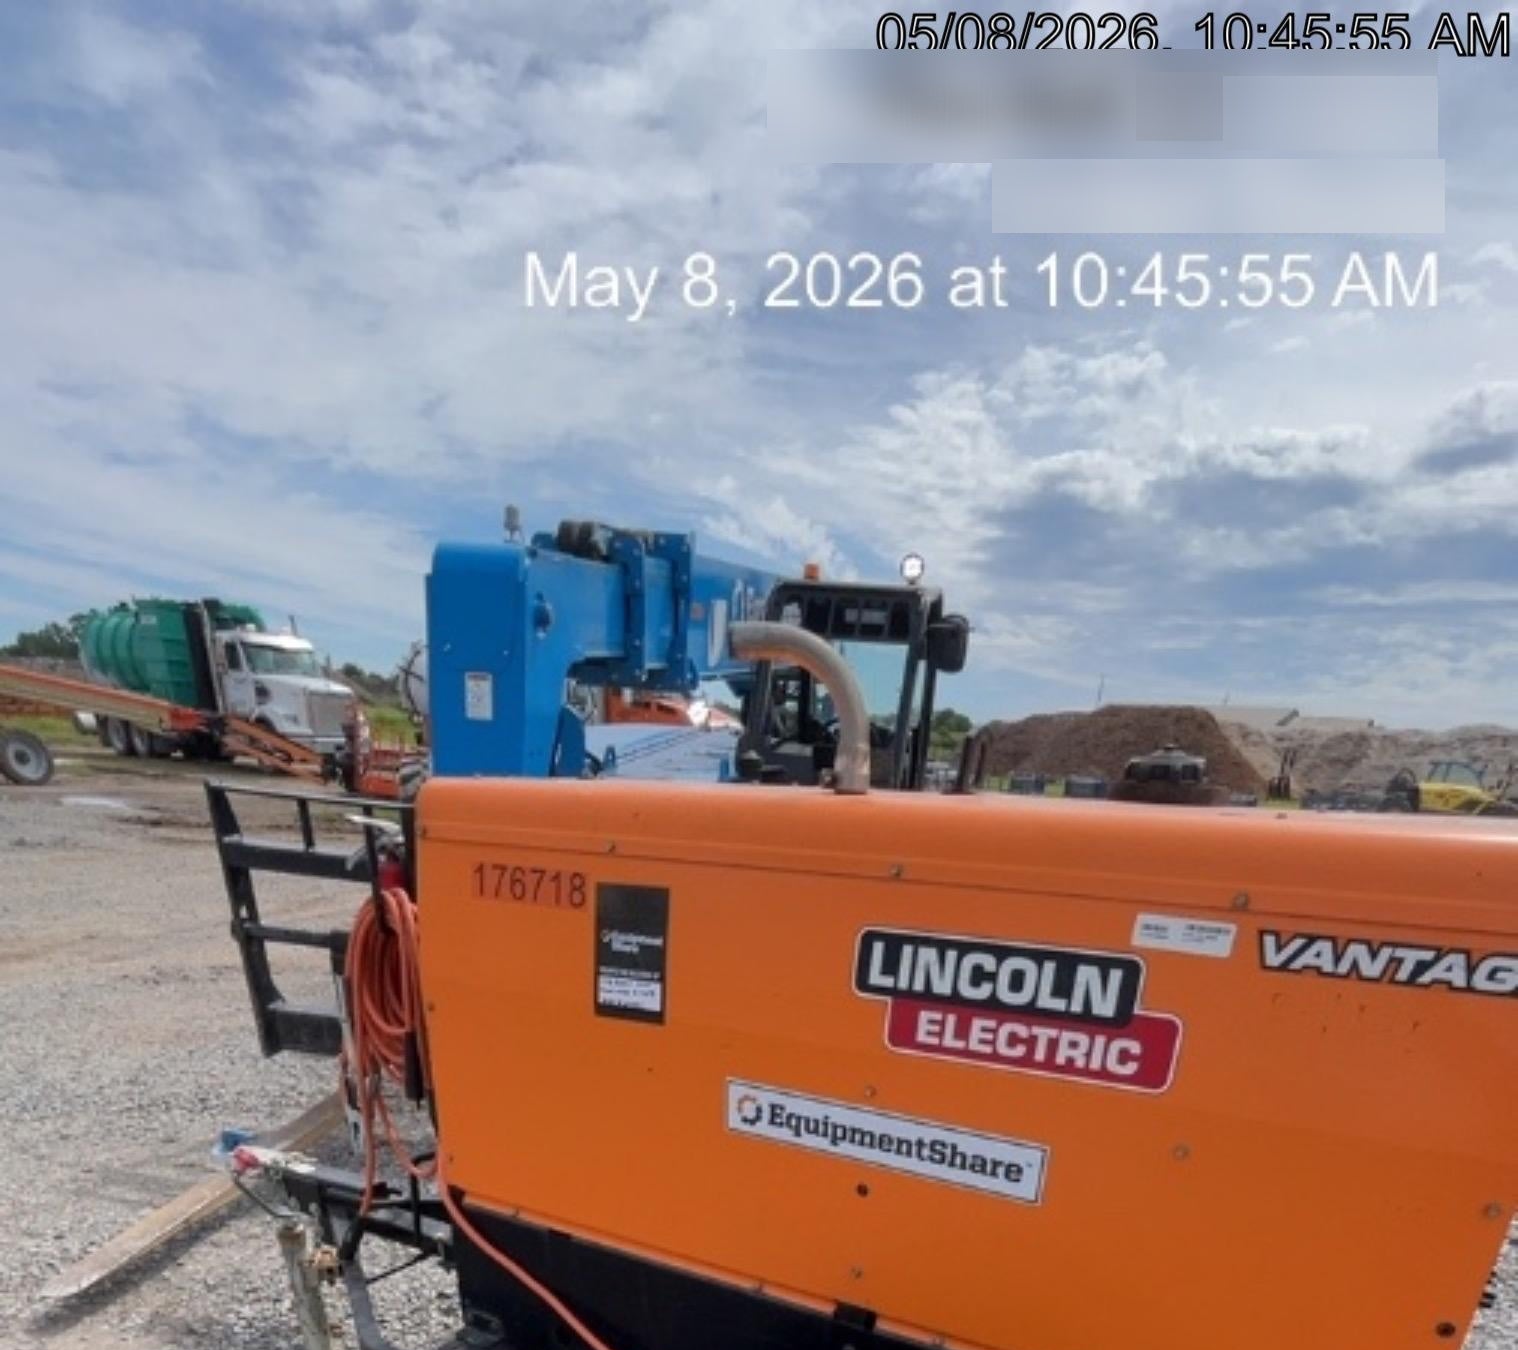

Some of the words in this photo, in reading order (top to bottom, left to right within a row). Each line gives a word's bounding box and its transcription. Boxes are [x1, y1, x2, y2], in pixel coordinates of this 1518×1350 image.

[473, 863, 587, 909] 176718
[867, 940, 1124, 1018] LINCOLN
[915, 1009, 1142, 1076] ELECTRIC
[767, 1102, 1025, 1184] EquipmentShare
